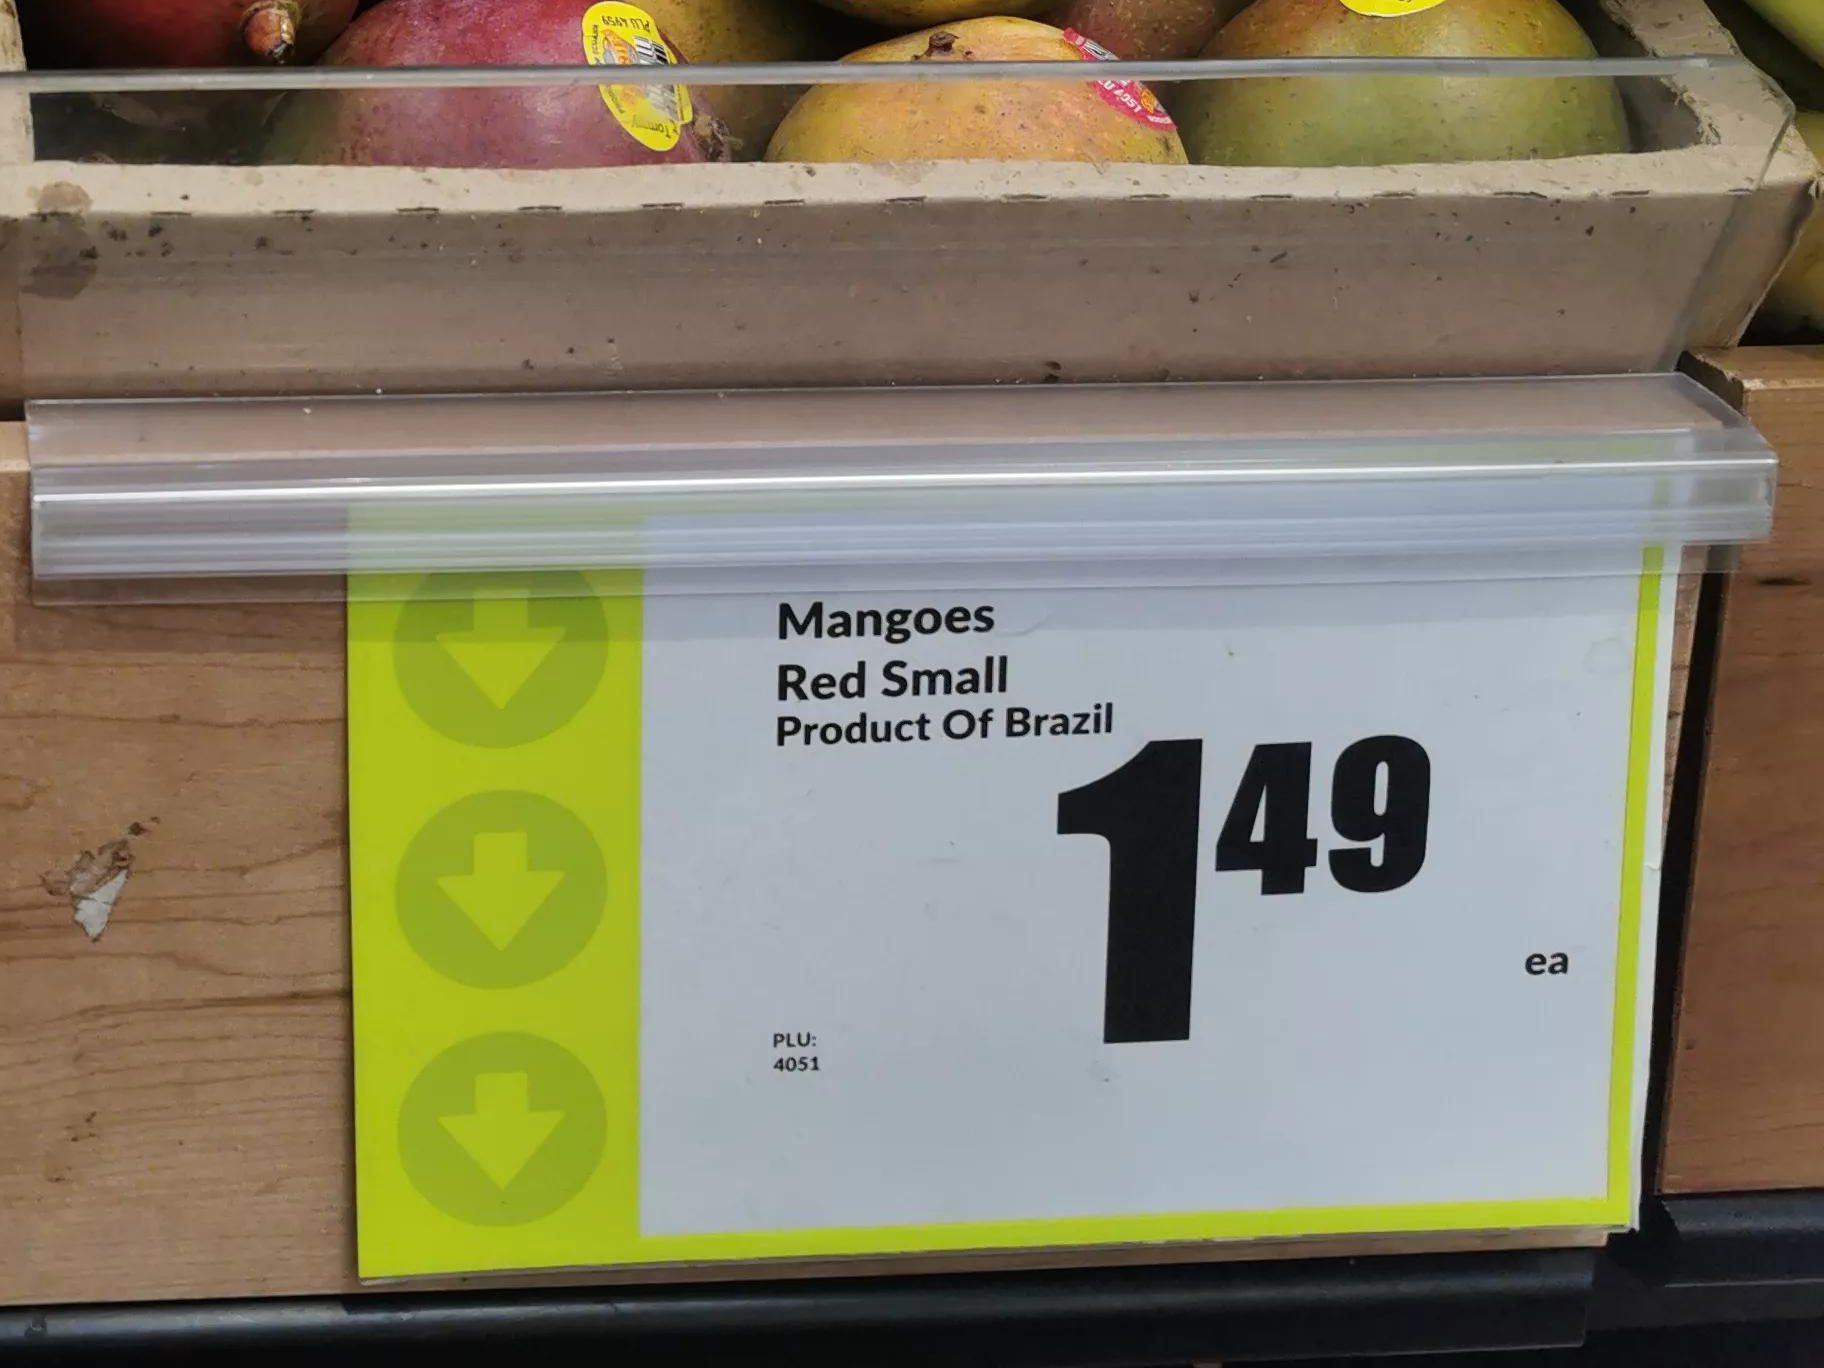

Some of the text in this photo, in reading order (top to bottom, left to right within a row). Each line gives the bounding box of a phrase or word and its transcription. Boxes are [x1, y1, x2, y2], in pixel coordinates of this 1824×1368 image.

[630, 16, 652, 33] PLU
[778, 601, 996, 645] Mangoes
[777, 655, 1008, 702] Red Small
[776, 701, 1114, 747] Product Of Brazil
[1524, 950, 1571, 977] ea
[772, 1031, 818, 1049] PLU:
[772, 1056, 820, 1073] 4051
